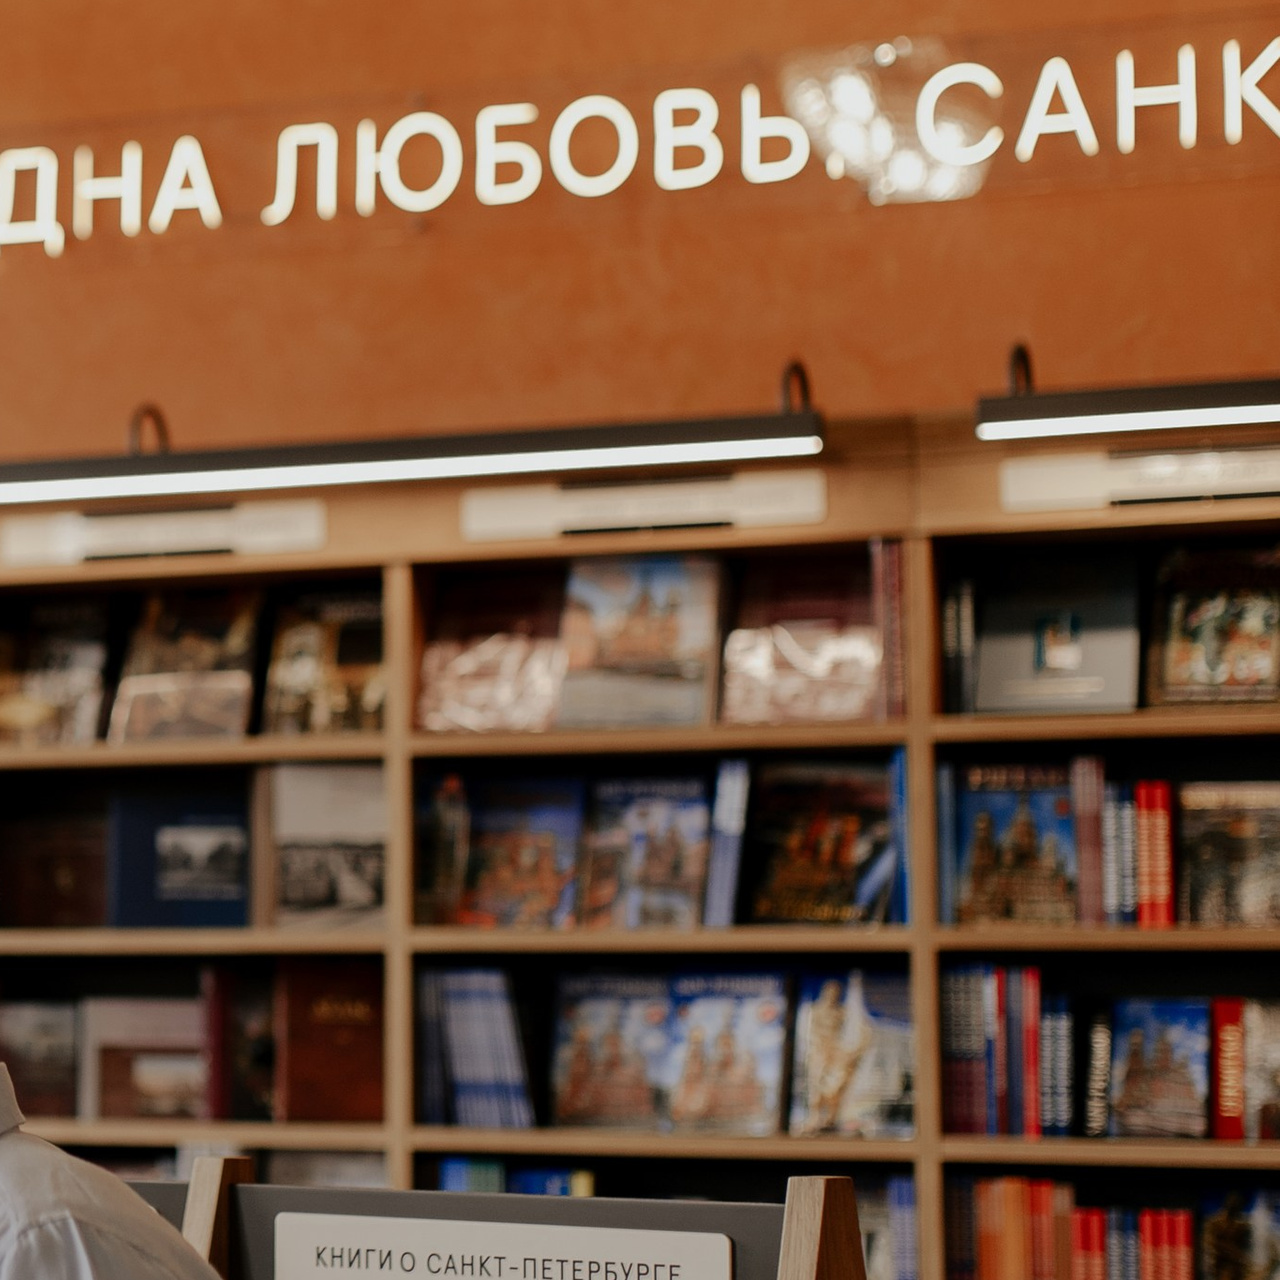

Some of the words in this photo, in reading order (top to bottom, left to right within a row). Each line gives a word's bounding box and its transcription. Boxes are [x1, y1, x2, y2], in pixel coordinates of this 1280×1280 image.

[260, 82, 846, 226] ЛЮБОВЬ.
[315, 1245, 393, 1272] КНИГИ
[400, 1251, 416, 1273] О
